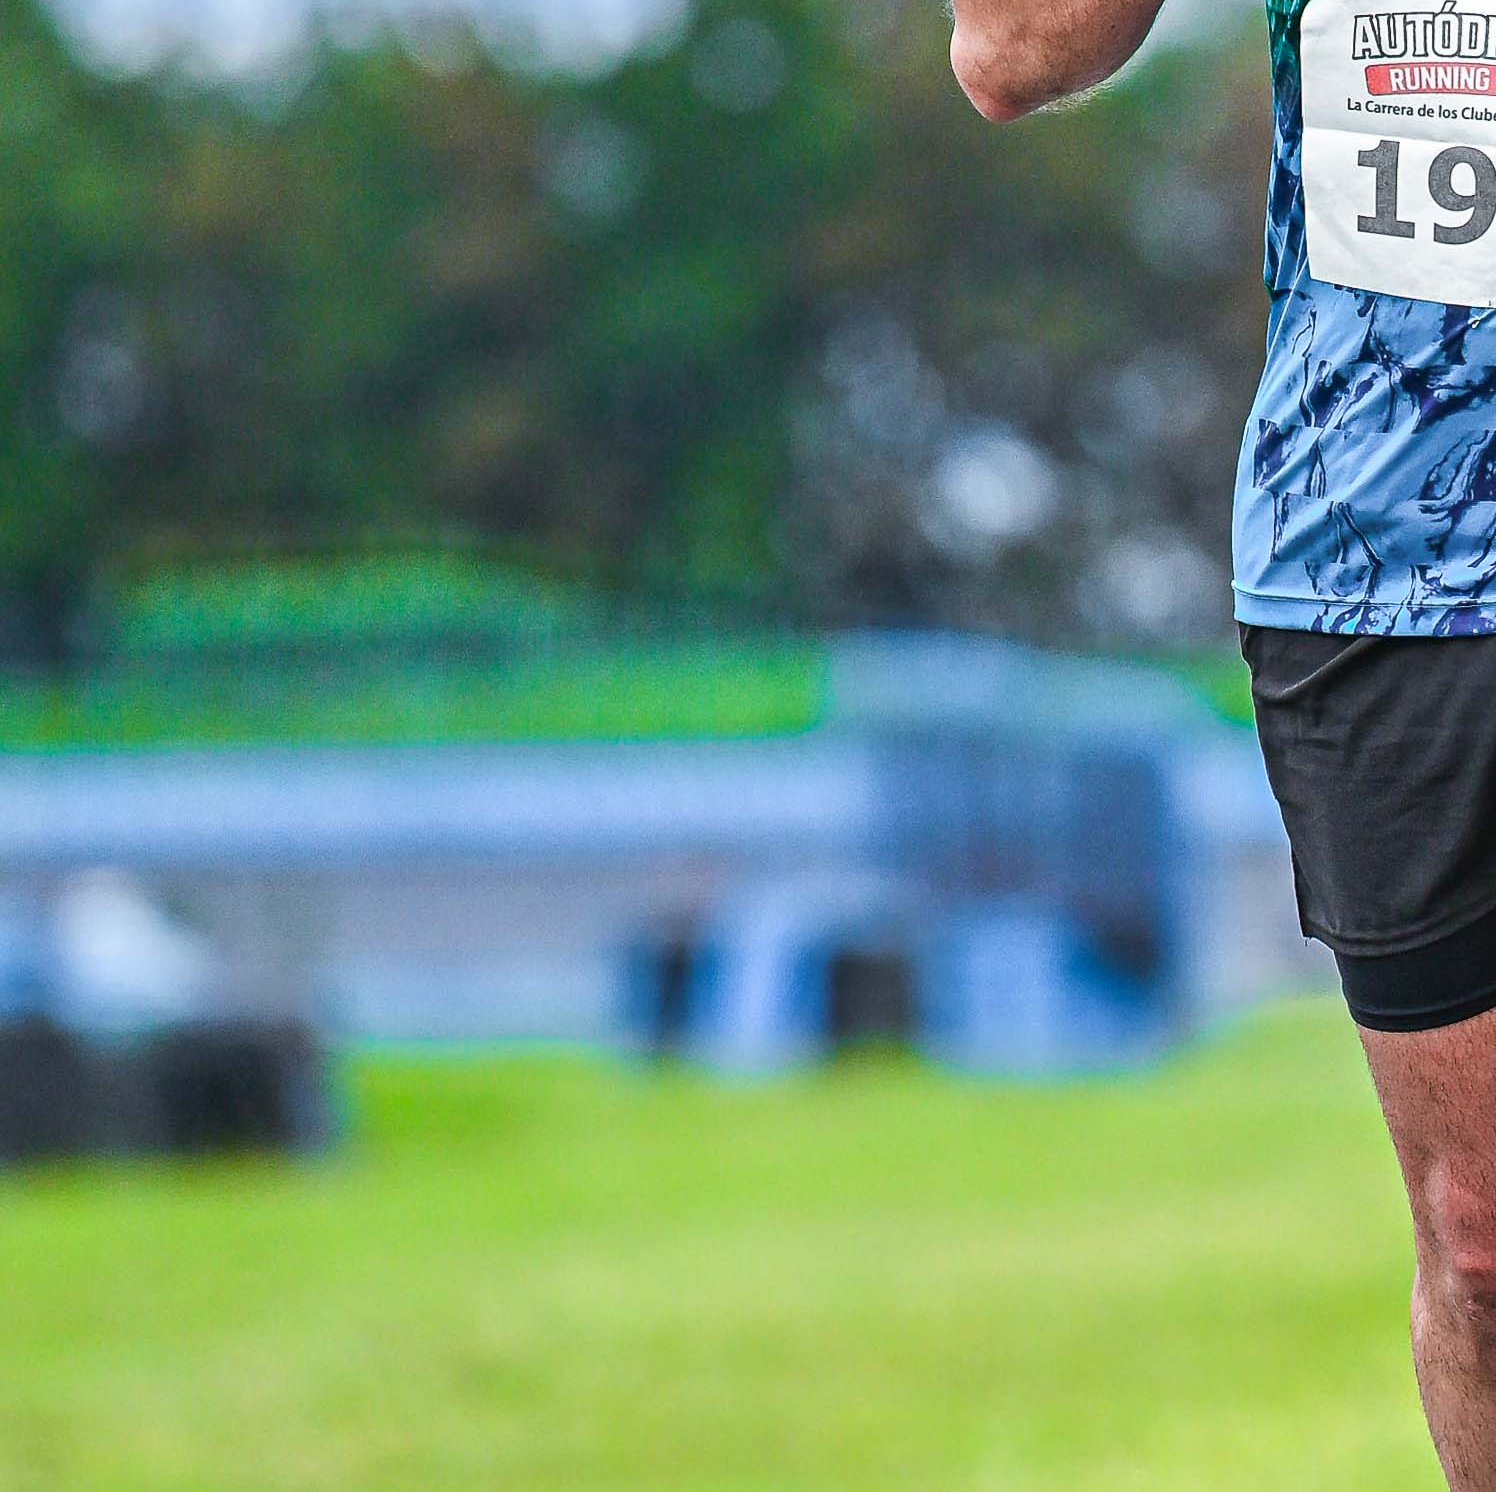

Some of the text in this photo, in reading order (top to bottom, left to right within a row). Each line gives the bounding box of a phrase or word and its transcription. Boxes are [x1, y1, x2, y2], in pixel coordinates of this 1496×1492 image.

[1389, 66, 1490, 92] RUNNING
[1347, 98, 1362, 112] La
[1365, 100, 1414, 117] Carrera
[1417, 104, 1435, 118] de
[1438, 105, 1458, 120] los
